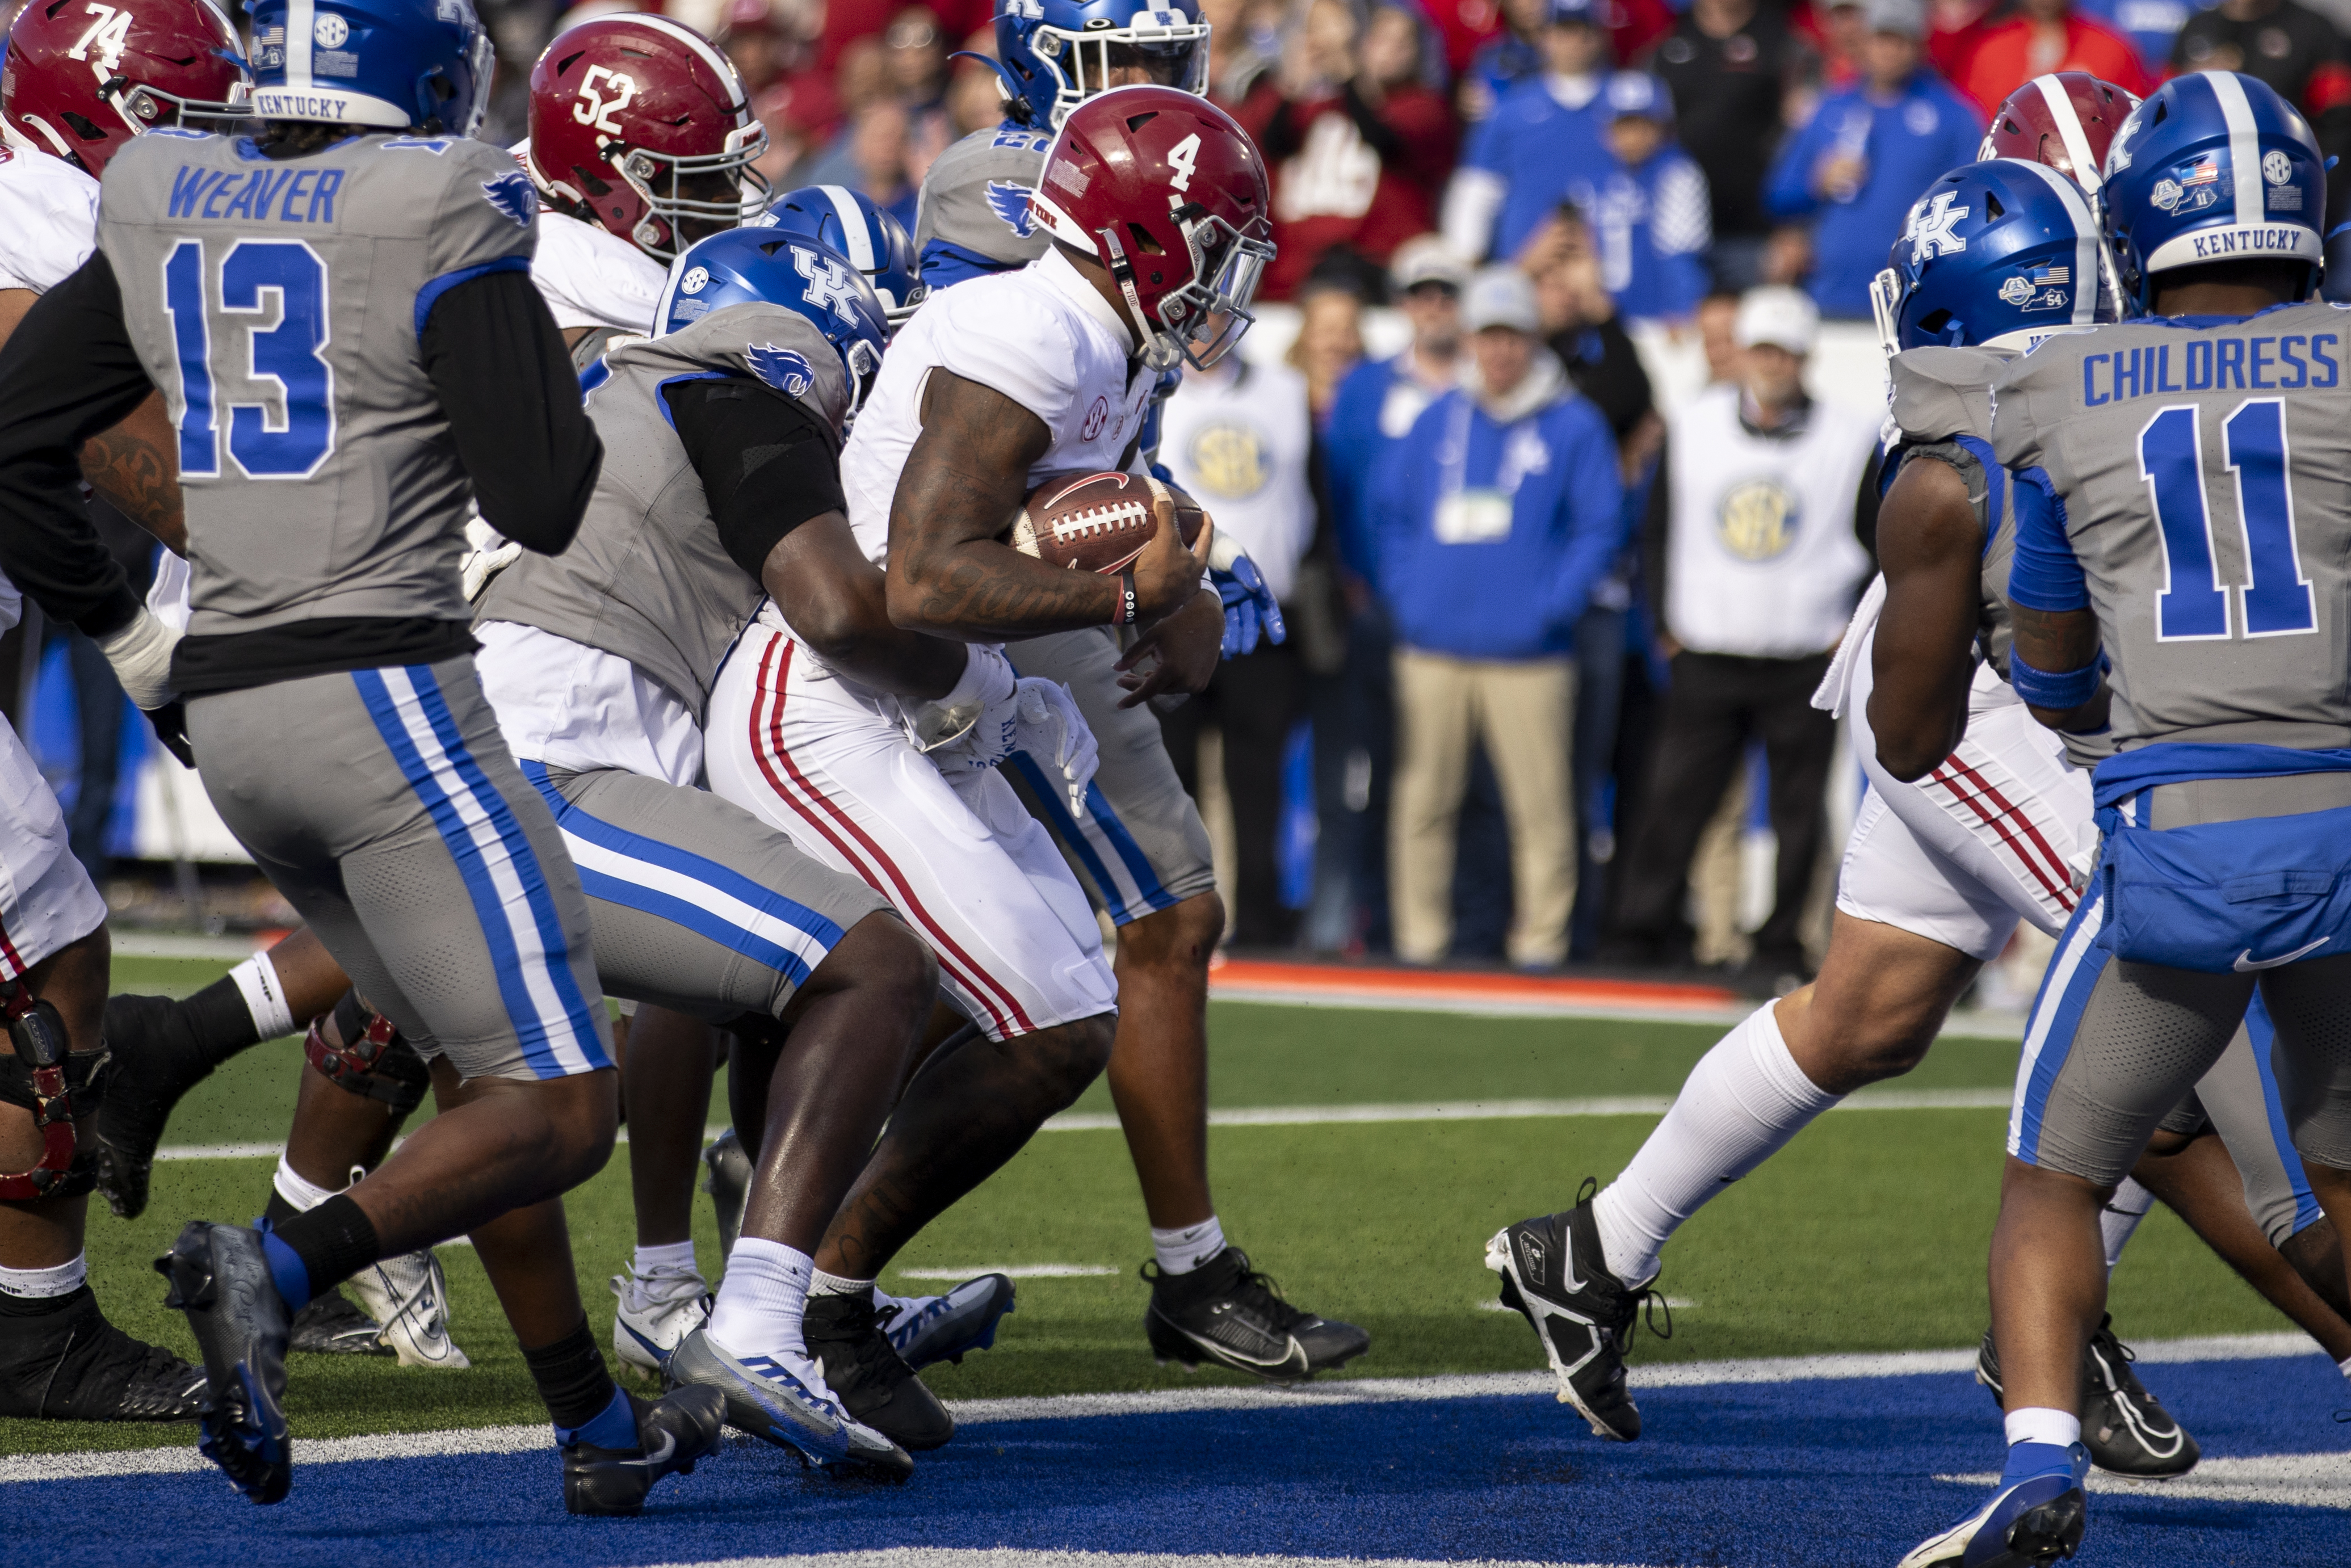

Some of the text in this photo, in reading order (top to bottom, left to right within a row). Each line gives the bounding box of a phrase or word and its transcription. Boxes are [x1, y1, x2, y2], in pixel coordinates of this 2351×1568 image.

[68, 2, 133, 70] 74
[316, 15, 347, 47] SEC
[270, 52, 278, 64] 13
[258, 94, 347, 119] KENTUCKY
[573, 64, 636, 135] 52
[1168, 133, 1201, 192] 4
[2264, 152, 2291, 185] SEC
[167, 166, 345, 223] WEAVER
[2196, 192, 2207, 205] 11
[1906, 191, 1970, 266] UK
[2193, 229, 2300, 258] KENTUCKY
[1187, 234, 1200, 269] CRIMSO
[682, 268, 708, 293] SEC
[790, 245, 862, 329] UK
[1126, 288, 1139, 307] TIDE
[2047, 294, 2062, 306] 54
[162, 238, 335, 480] 13
[2084, 334, 2339, 407] CHILDRESS
[1083, 397, 1108, 442] SEC
[2138, 397, 2319, 642] 11
